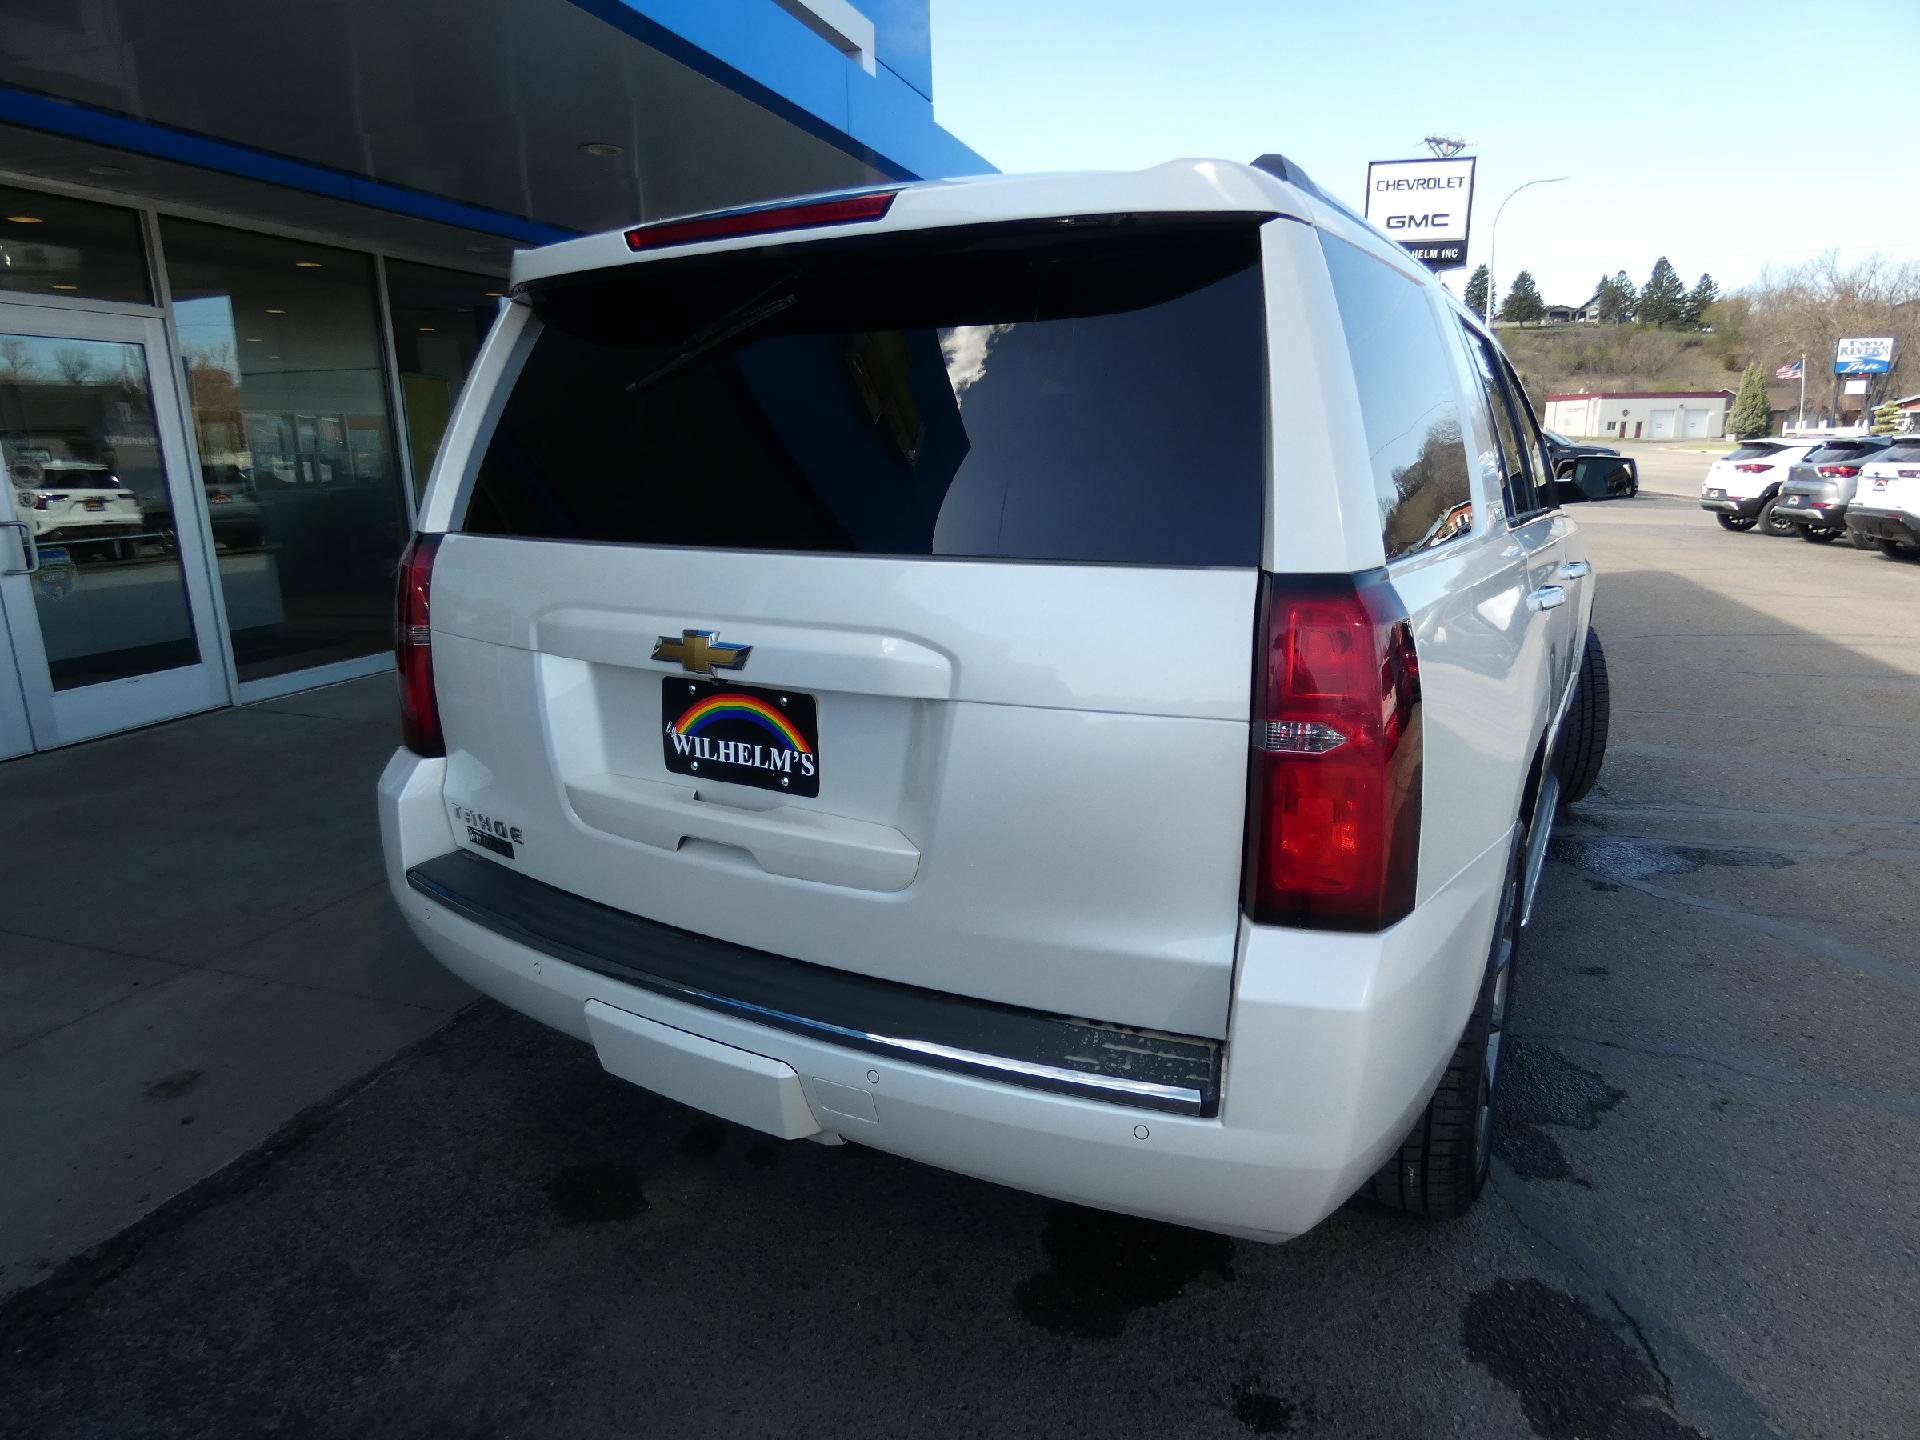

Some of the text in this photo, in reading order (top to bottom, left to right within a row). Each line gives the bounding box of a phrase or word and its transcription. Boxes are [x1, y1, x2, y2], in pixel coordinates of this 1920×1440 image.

[1376, 176, 1466, 192] CHEVROLET
[1386, 213, 1450, 229] GMC
[1441, 248, 1459, 259] INC
[673, 732, 815, 777] WILHELM'S
[450, 802, 525, 845] TAHOE
